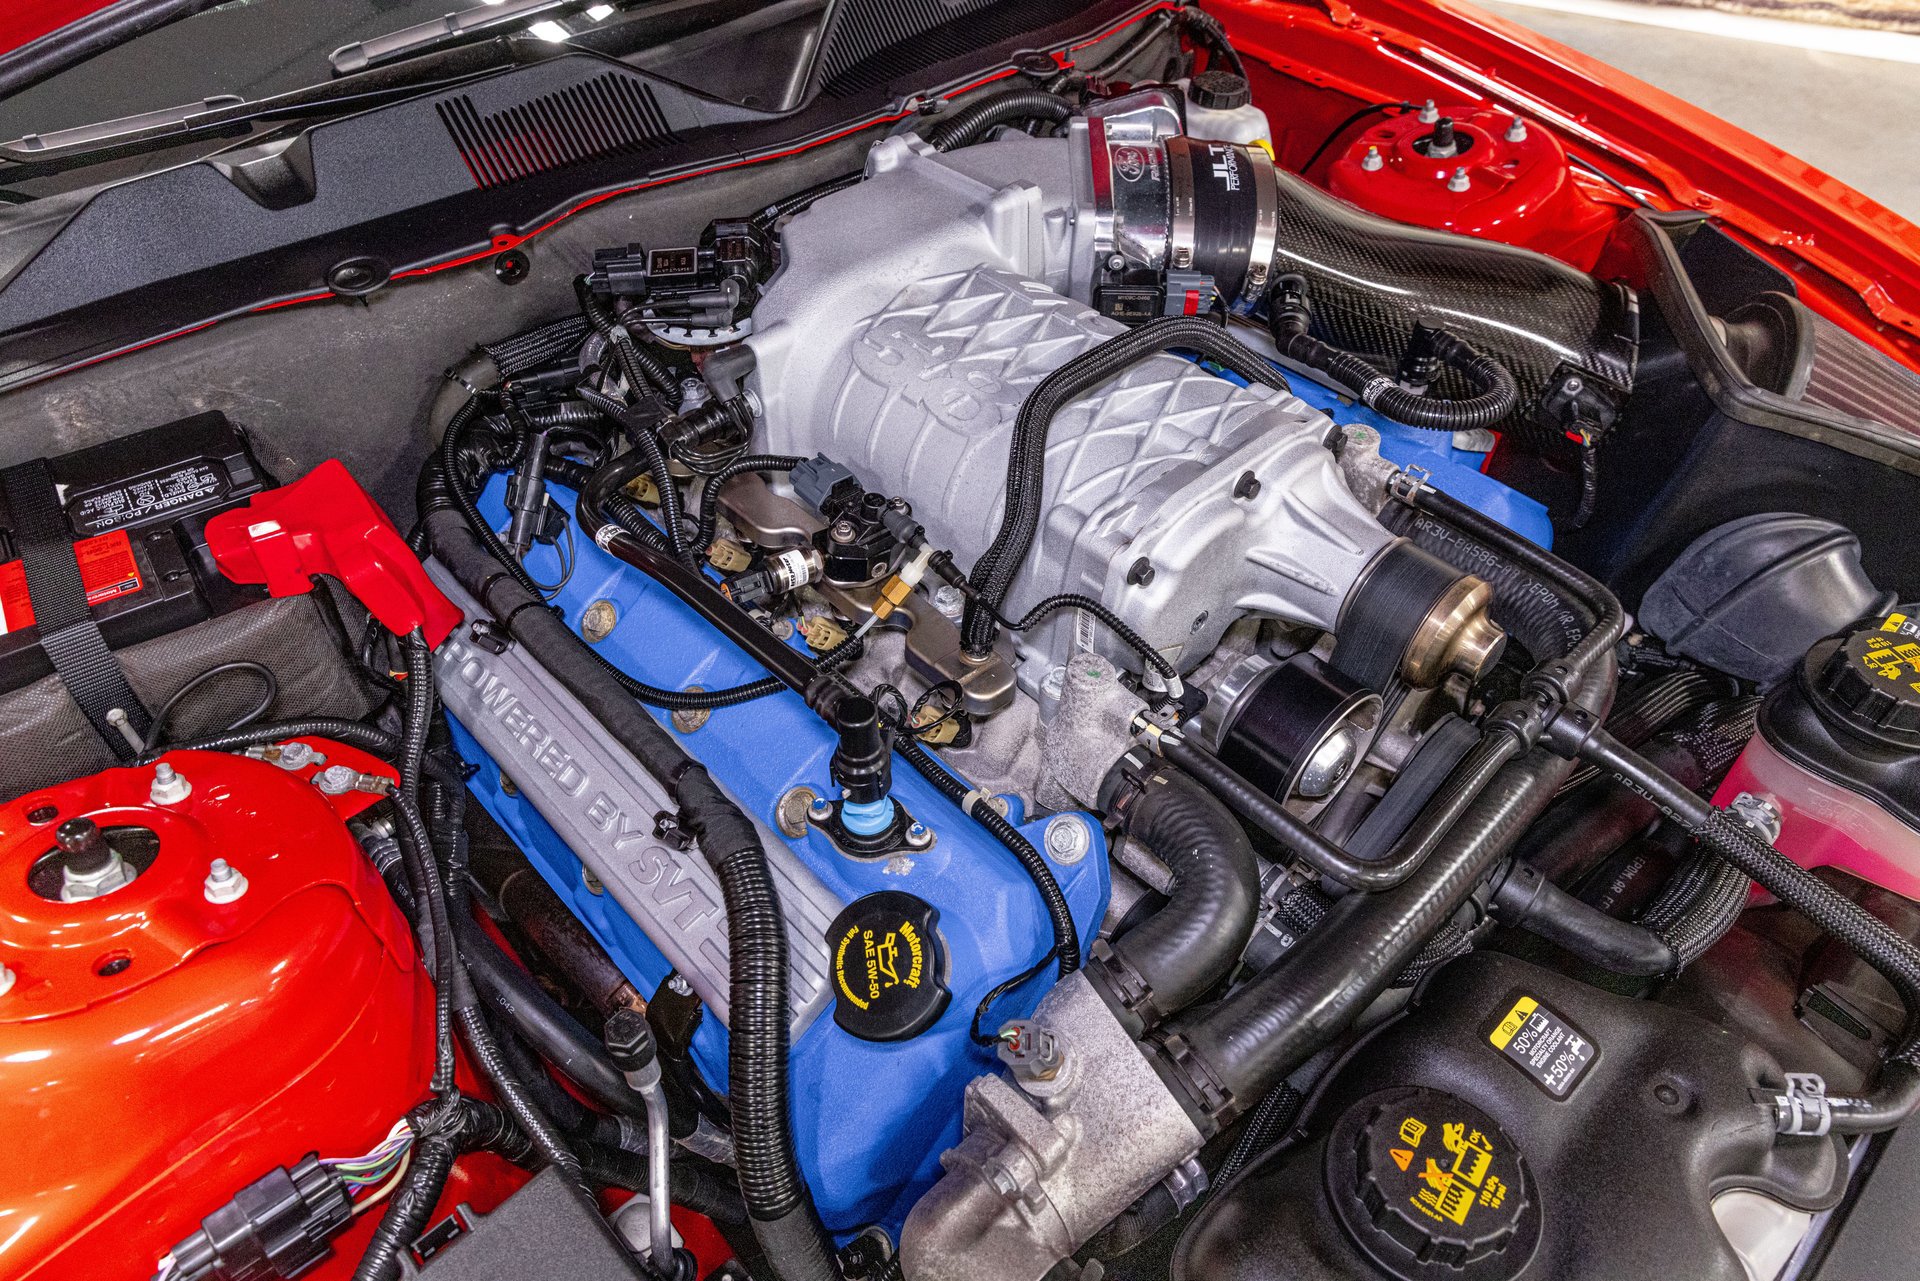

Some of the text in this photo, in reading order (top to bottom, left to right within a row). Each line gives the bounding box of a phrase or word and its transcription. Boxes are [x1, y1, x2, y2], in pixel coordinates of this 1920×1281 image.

[1118, 149, 1141, 175] Ford
[1208, 144, 1231, 191] JLT
[154, 490, 204, 510] DANGER
[443, 641, 719, 931] POWERED BY SVT
[836, 925, 869, 1010] Full Synthetic Recommended
[863, 929, 880, 999] SAE 5W-50
[899, 921, 923, 989] Motorcraft
[1512, 1028, 1538, 1054] 50%
[1528, 1027, 1552, 1057] MOTORCRAFT
[1529, 1026, 1562, 1066] SPECIALTY ORANGE
[1536, 1052, 1551, 1068] ENGINE
[1547, 1032, 1566, 1053] COOLANT
[1469, 1129, 1482, 1144] OK
[1479, 1175, 1499, 1207] 110 kPa
[1491, 1183, 1507, 1209] 16 psi
